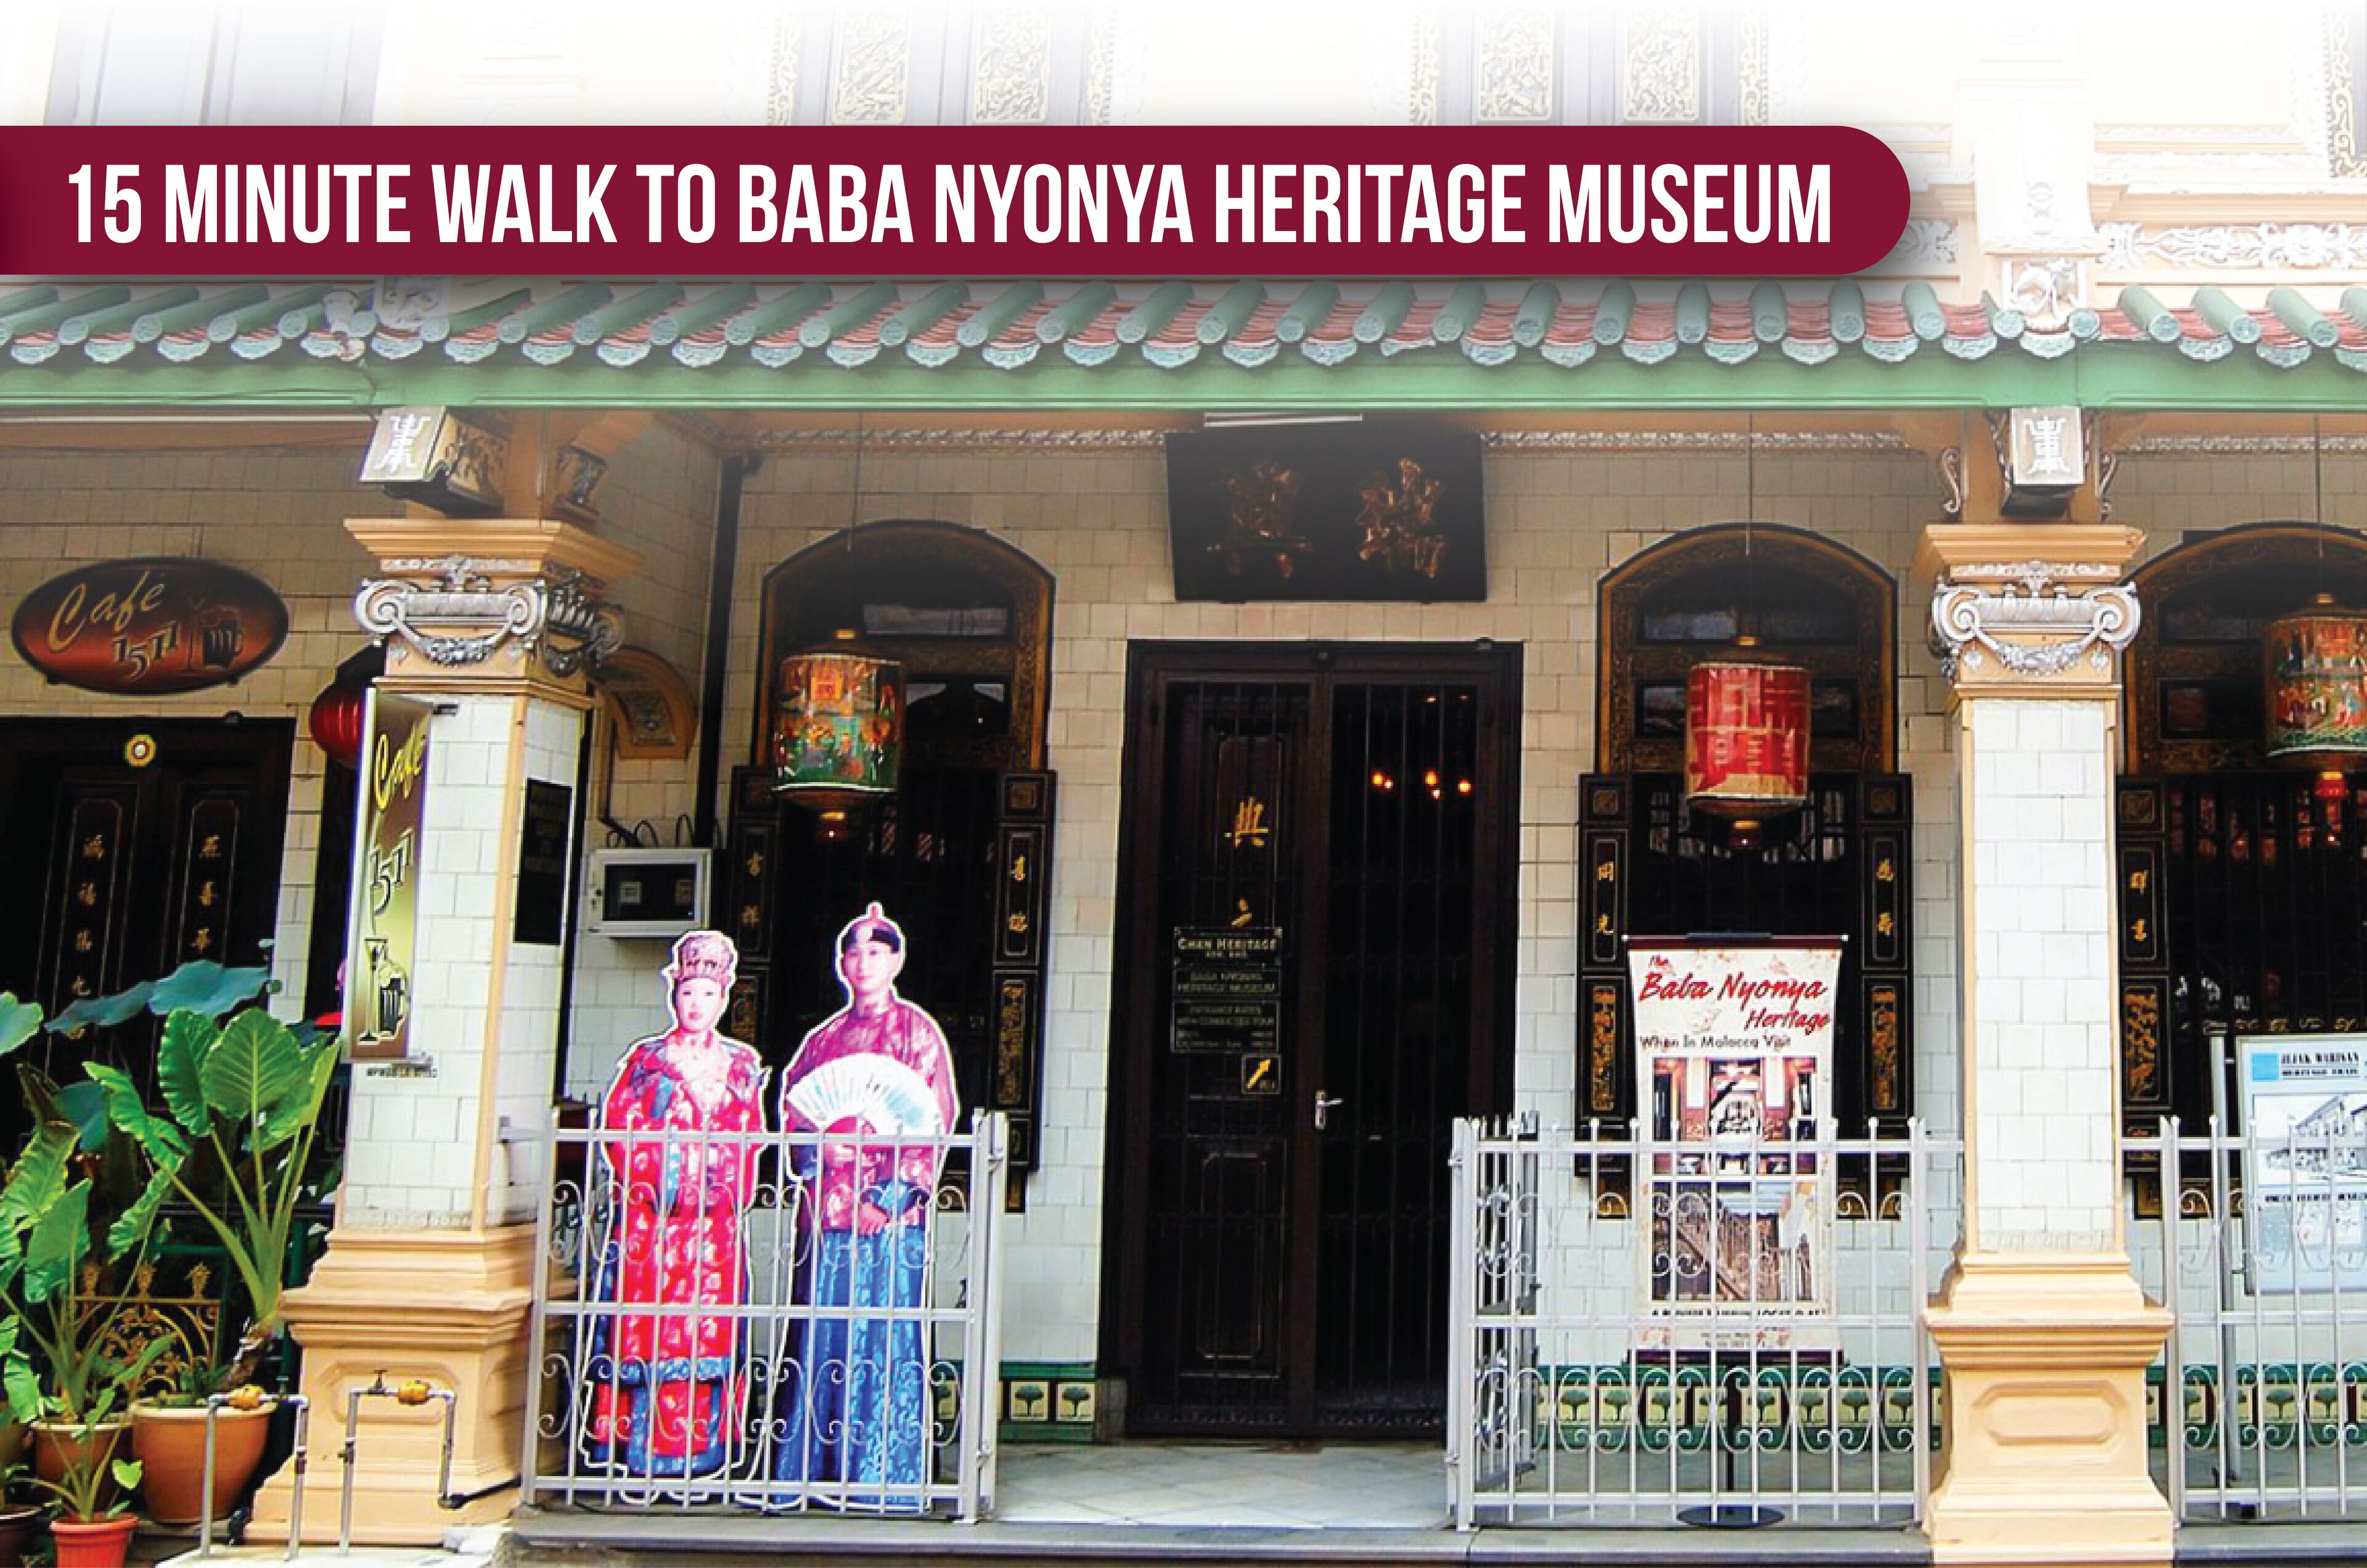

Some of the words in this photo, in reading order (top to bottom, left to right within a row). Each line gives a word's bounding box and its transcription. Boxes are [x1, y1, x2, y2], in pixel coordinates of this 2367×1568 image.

[1638, 971, 1714, 1002] Baba
[1717, 971, 1828, 1011] Nyonya
[1743, 1007, 1831, 1036] Heritage
[1640, 1035, 1679, 1050] When
[1683, 1035, 1696, 1048] In
